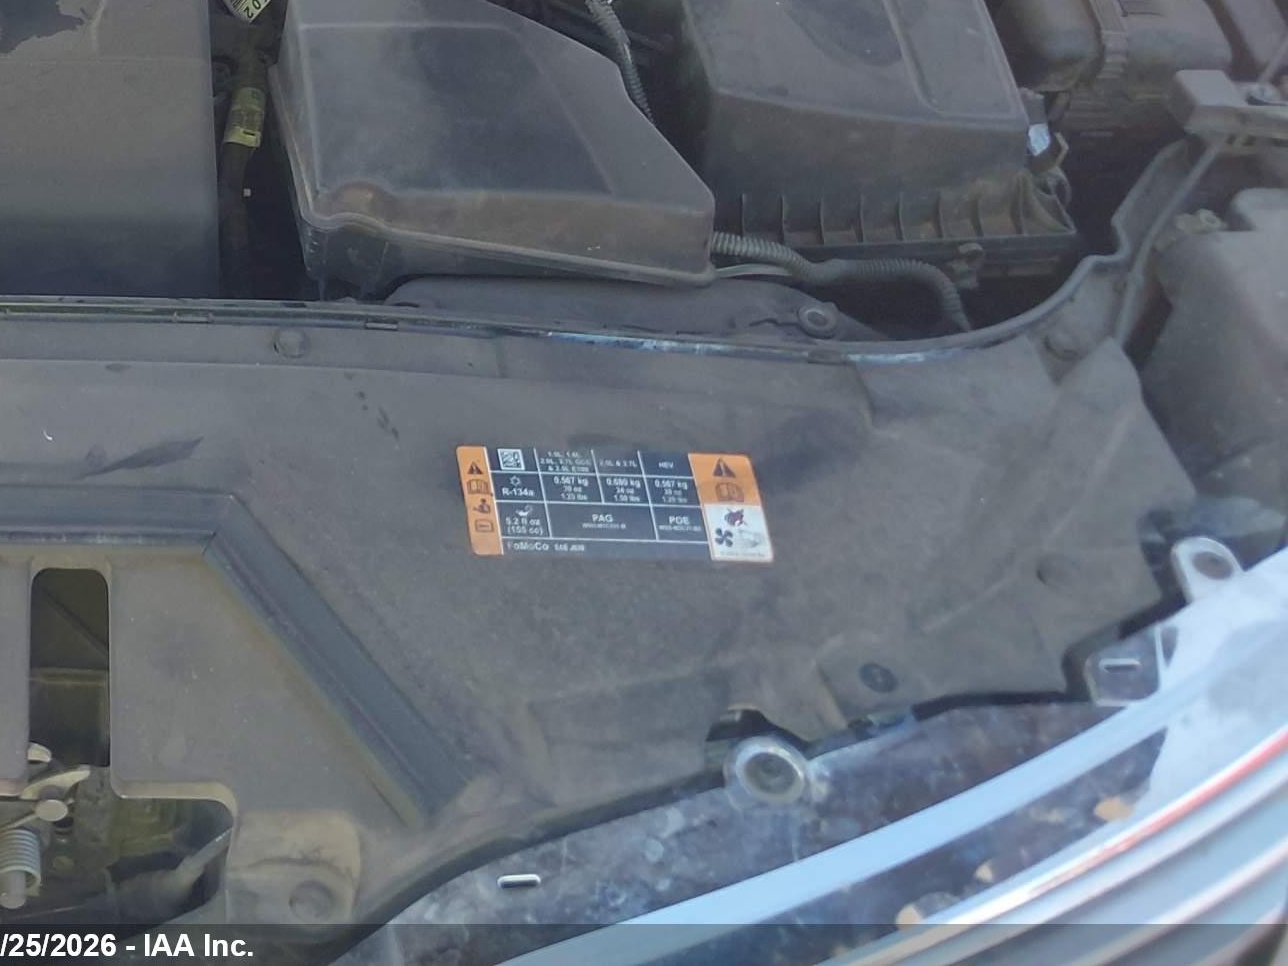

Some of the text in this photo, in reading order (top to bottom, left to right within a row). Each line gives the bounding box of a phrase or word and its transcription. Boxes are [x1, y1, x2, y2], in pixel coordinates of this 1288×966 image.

[577, 476, 589, 487] kg
[630, 478, 641, 488] kg
[677, 480, 688, 490] kg
[501, 487, 535, 497] R-134a
[505, 517, 519, 525] 5.2
[591, 513, 614, 523] PAG
[529, 527, 544, 536] cc)
